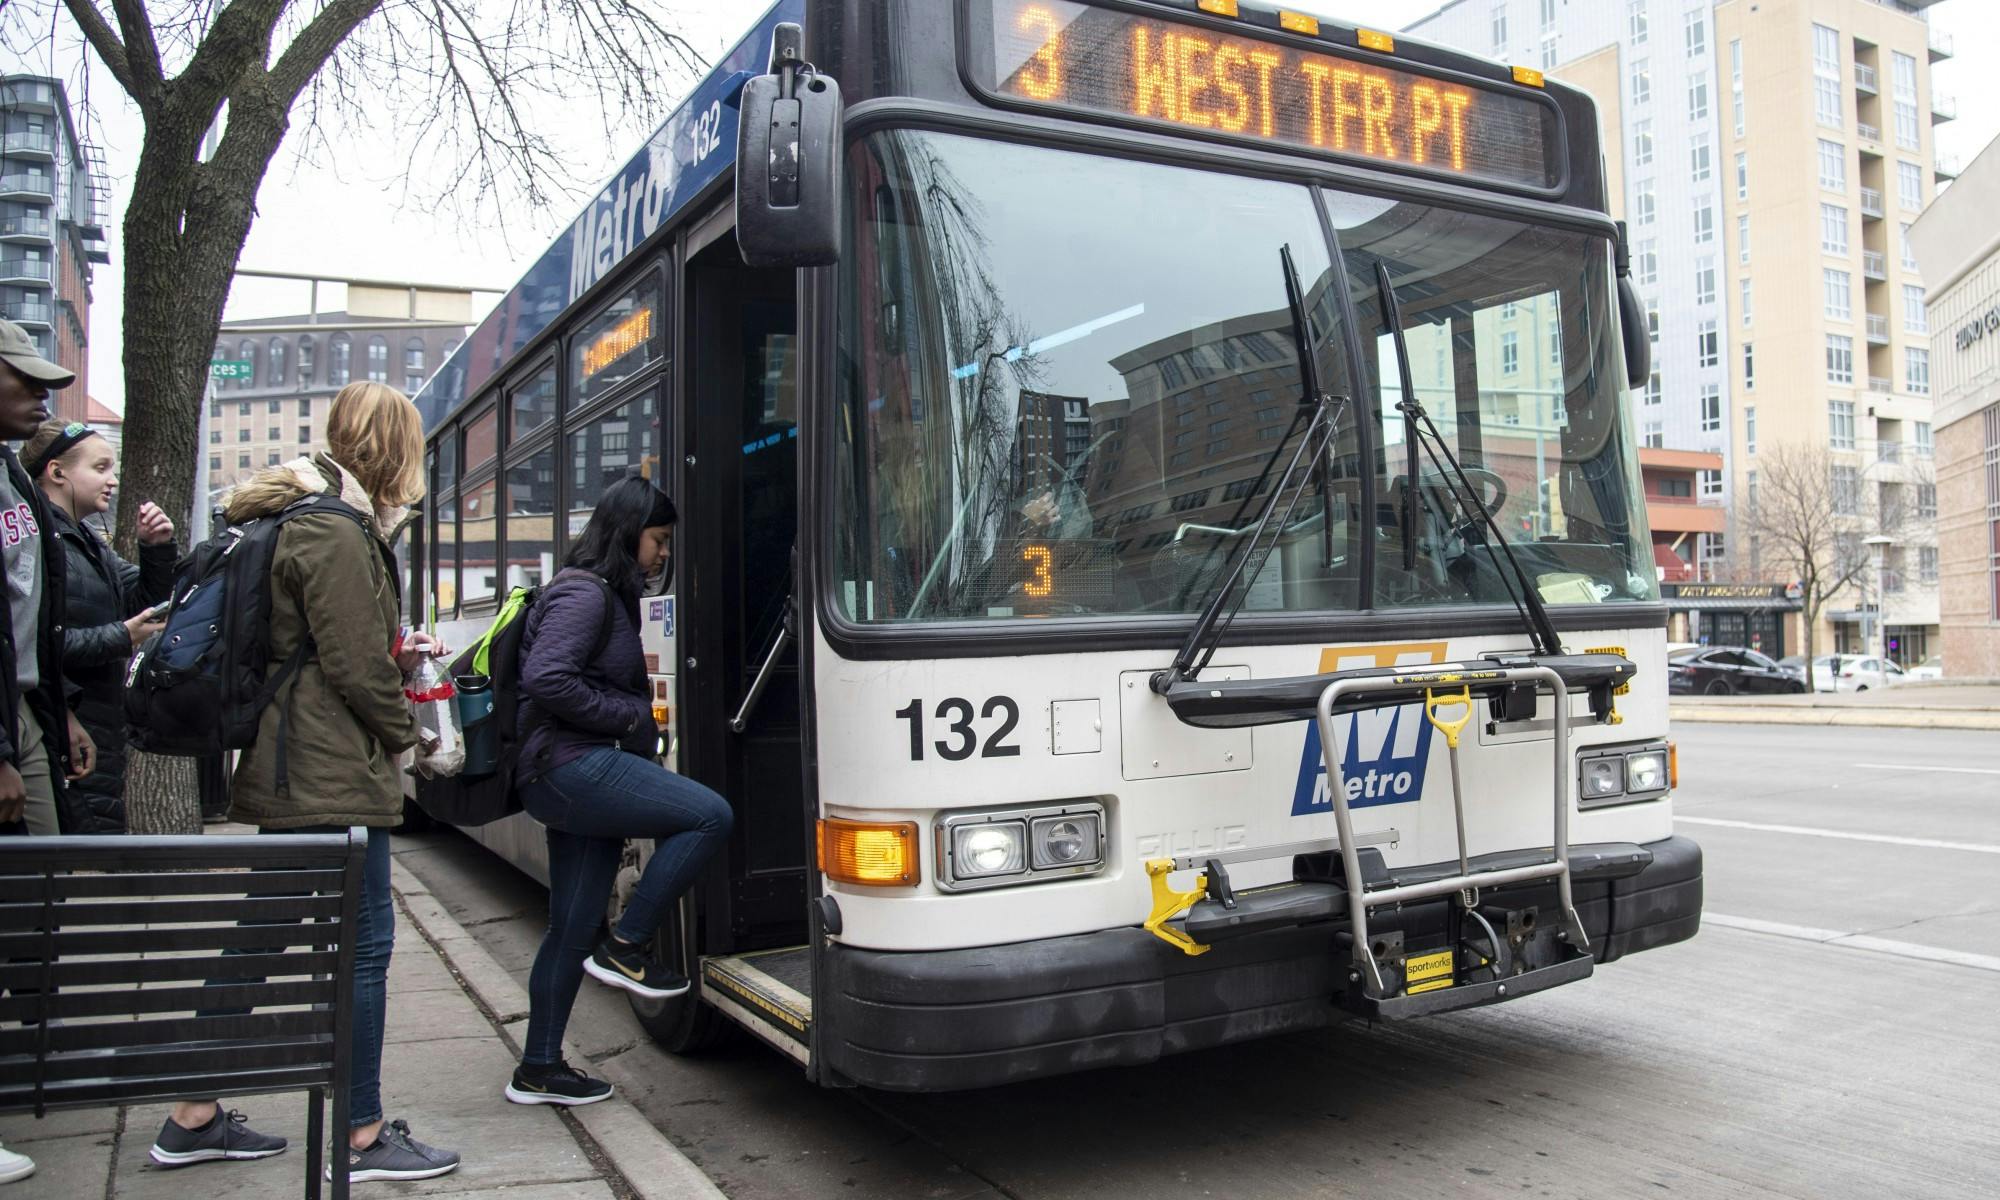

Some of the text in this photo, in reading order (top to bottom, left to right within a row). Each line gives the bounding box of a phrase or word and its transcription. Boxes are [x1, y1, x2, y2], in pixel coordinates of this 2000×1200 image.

[1019, 7, 1469, 171] 3 WEST TFR PT
[690, 99, 721, 168] 132
[568, 172, 665, 305] Metro
[1023, 546, 1052, 596] 3
[895, 694, 1021, 762] 132
[1311, 769, 1412, 805] Metro
[1407, 956, 1451, 975] sportworks
